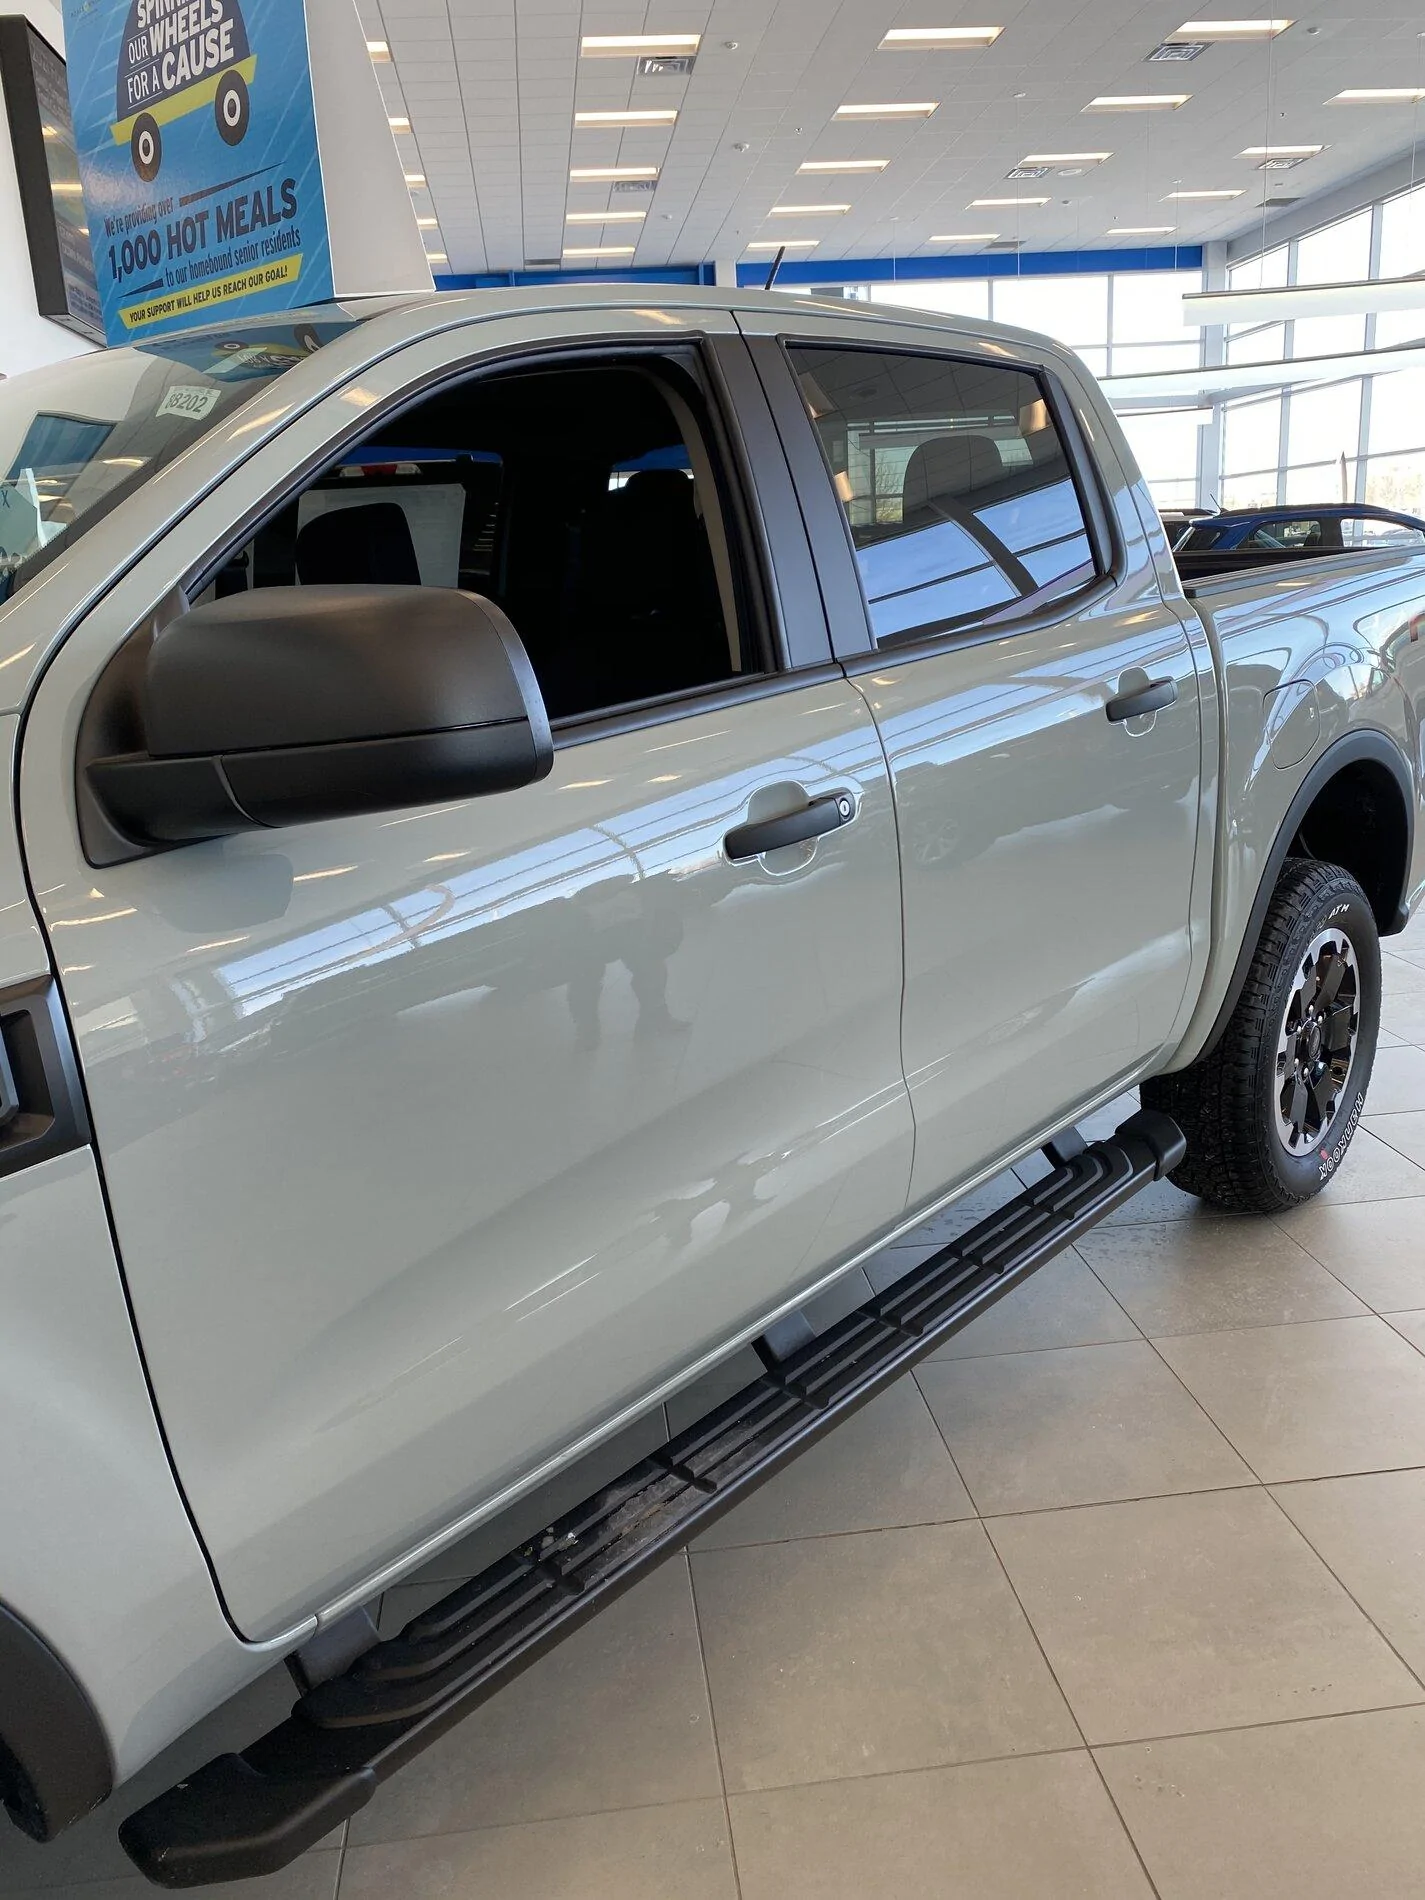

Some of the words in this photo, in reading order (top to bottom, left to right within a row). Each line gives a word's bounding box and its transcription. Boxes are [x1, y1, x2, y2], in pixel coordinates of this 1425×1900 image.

[127, 71, 149, 103] FOR
[152, 65, 160, 92] A
[162, 19, 234, 90] CAUSE
[128, 36, 148, 63] OUR
[149, 0, 223, 56] WHEELS
[104, 215, 124, 238] We're
[125, 203, 157, 234] providing
[158, 197, 174, 218] over
[109, 229, 161, 283] 1,000
[166, 210, 209, 260] HOT
[216, 178, 297, 243] MEALS
[166, 267, 174, 287] to
[175, 266, 187, 284] our
[188, 246, 233, 279] homebound
[234, 240, 258, 265] senior
[261, 225, 301, 257] residents
[129, 309, 146, 323] YOUR
[147, 300, 175, 317] SUPPORT
[176, 296, 192, 309] WILL
[193, 291, 210, 304] HELP
[211, 286, 222, 298] US
[223, 278, 247, 295] REACH
[249, 273, 264, 288] OUR
[265, 265, 288, 283] GOAL!
[1318, 1092, 1364, 1180] HANKOOK
